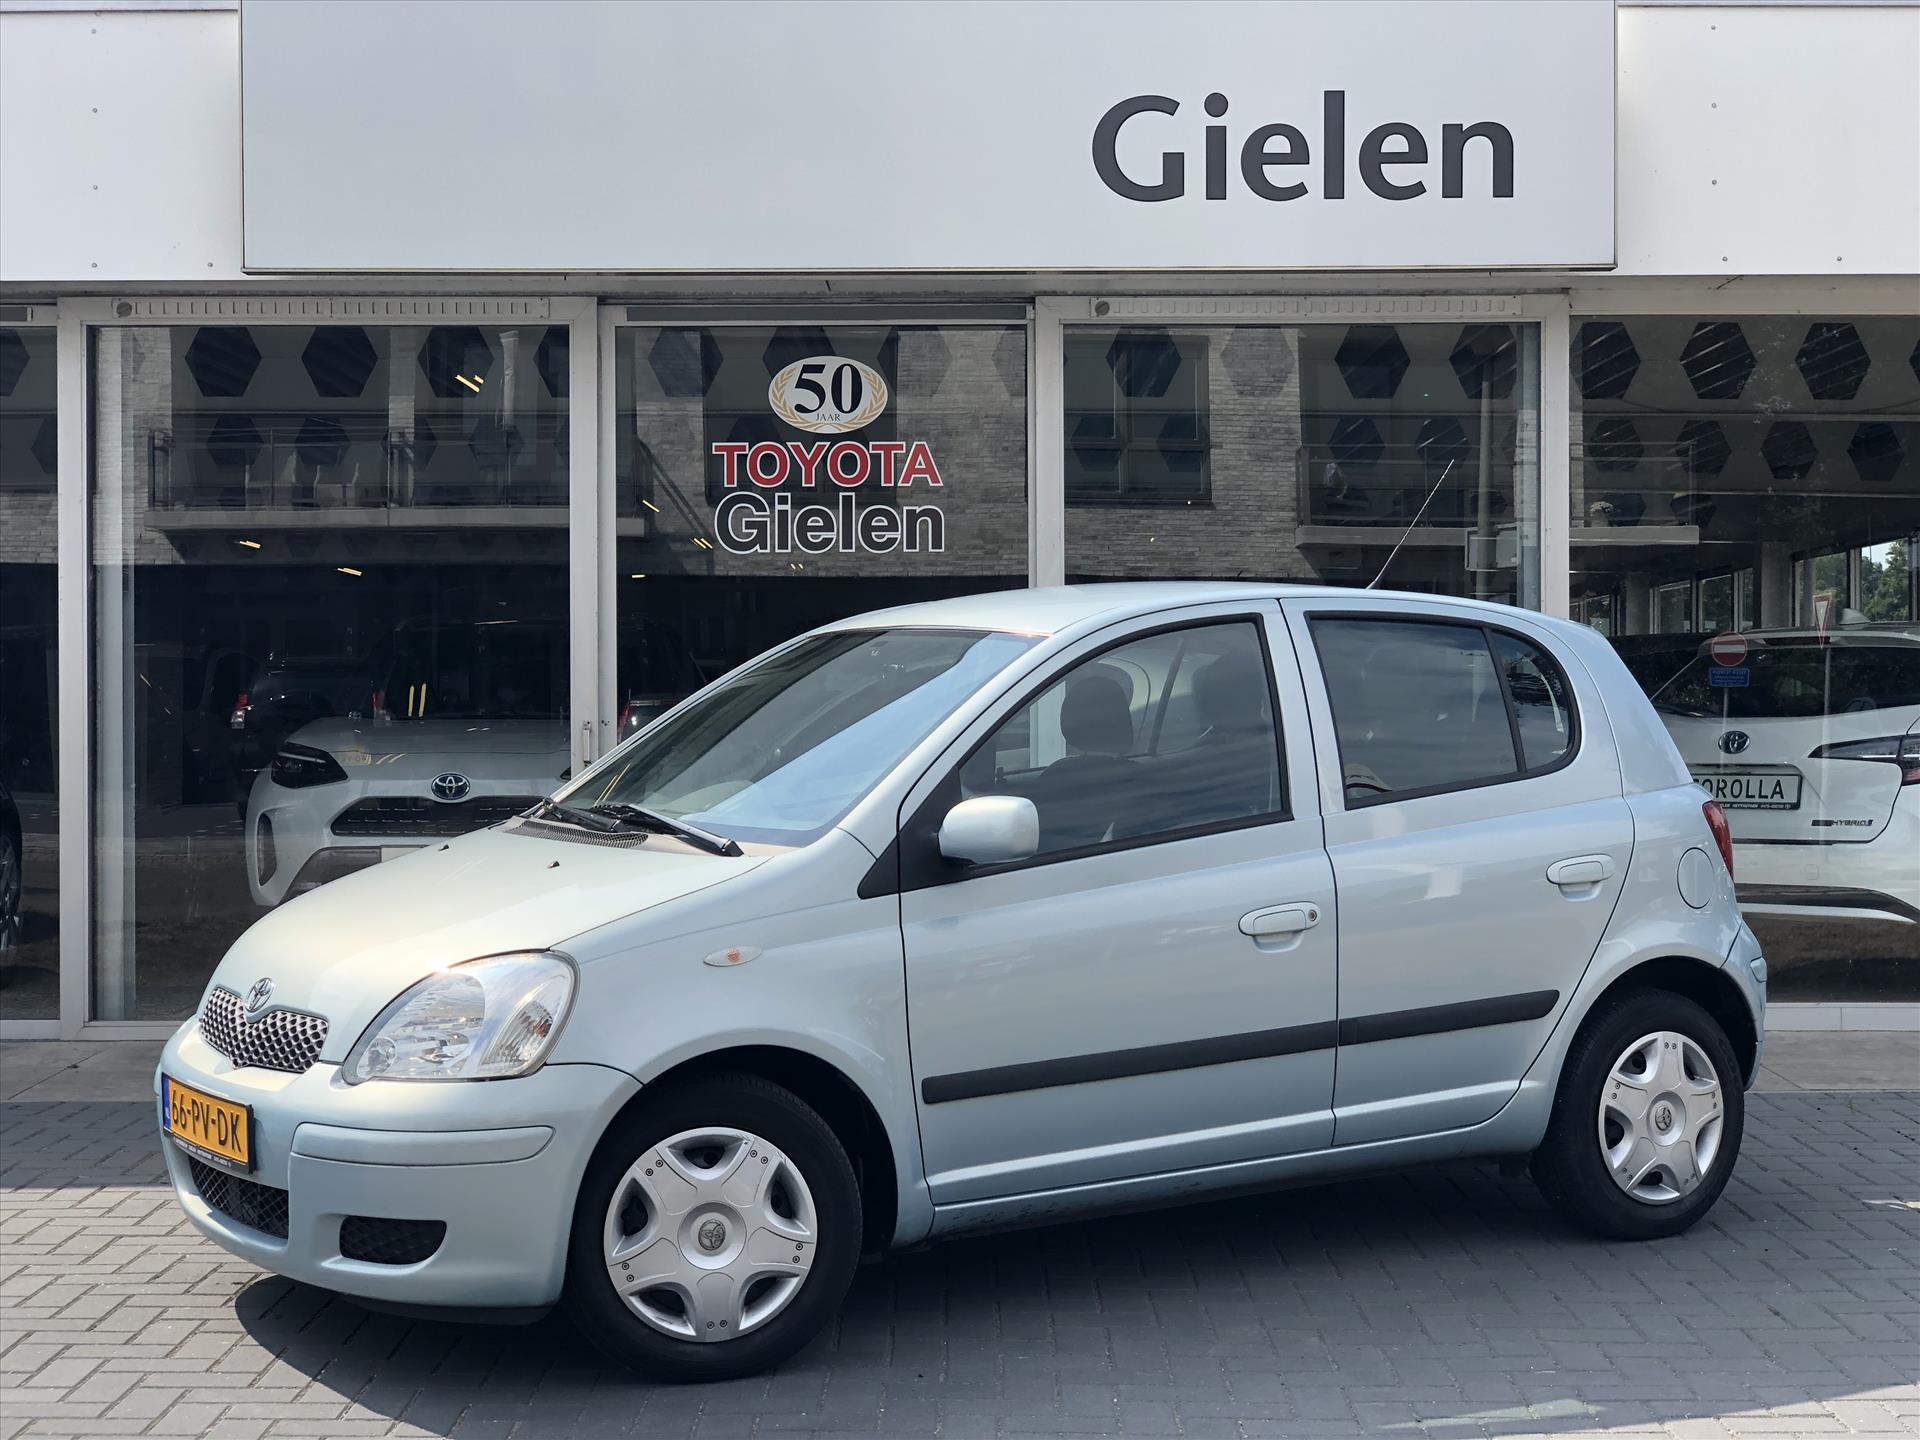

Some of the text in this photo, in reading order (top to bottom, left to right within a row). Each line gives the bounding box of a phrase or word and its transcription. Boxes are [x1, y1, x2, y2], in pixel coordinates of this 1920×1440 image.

[1092, 90, 1514, 201] Gielen
[794, 363, 863, 414] 50
[815, 413, 841, 422] JAAR
[712, 441, 943, 488] TOYOTA
[714, 491, 945, 554] Gielen
[1693, 778, 1785, 800] OROLLA
[172, 1089, 242, 1153] 66-PV-DK
